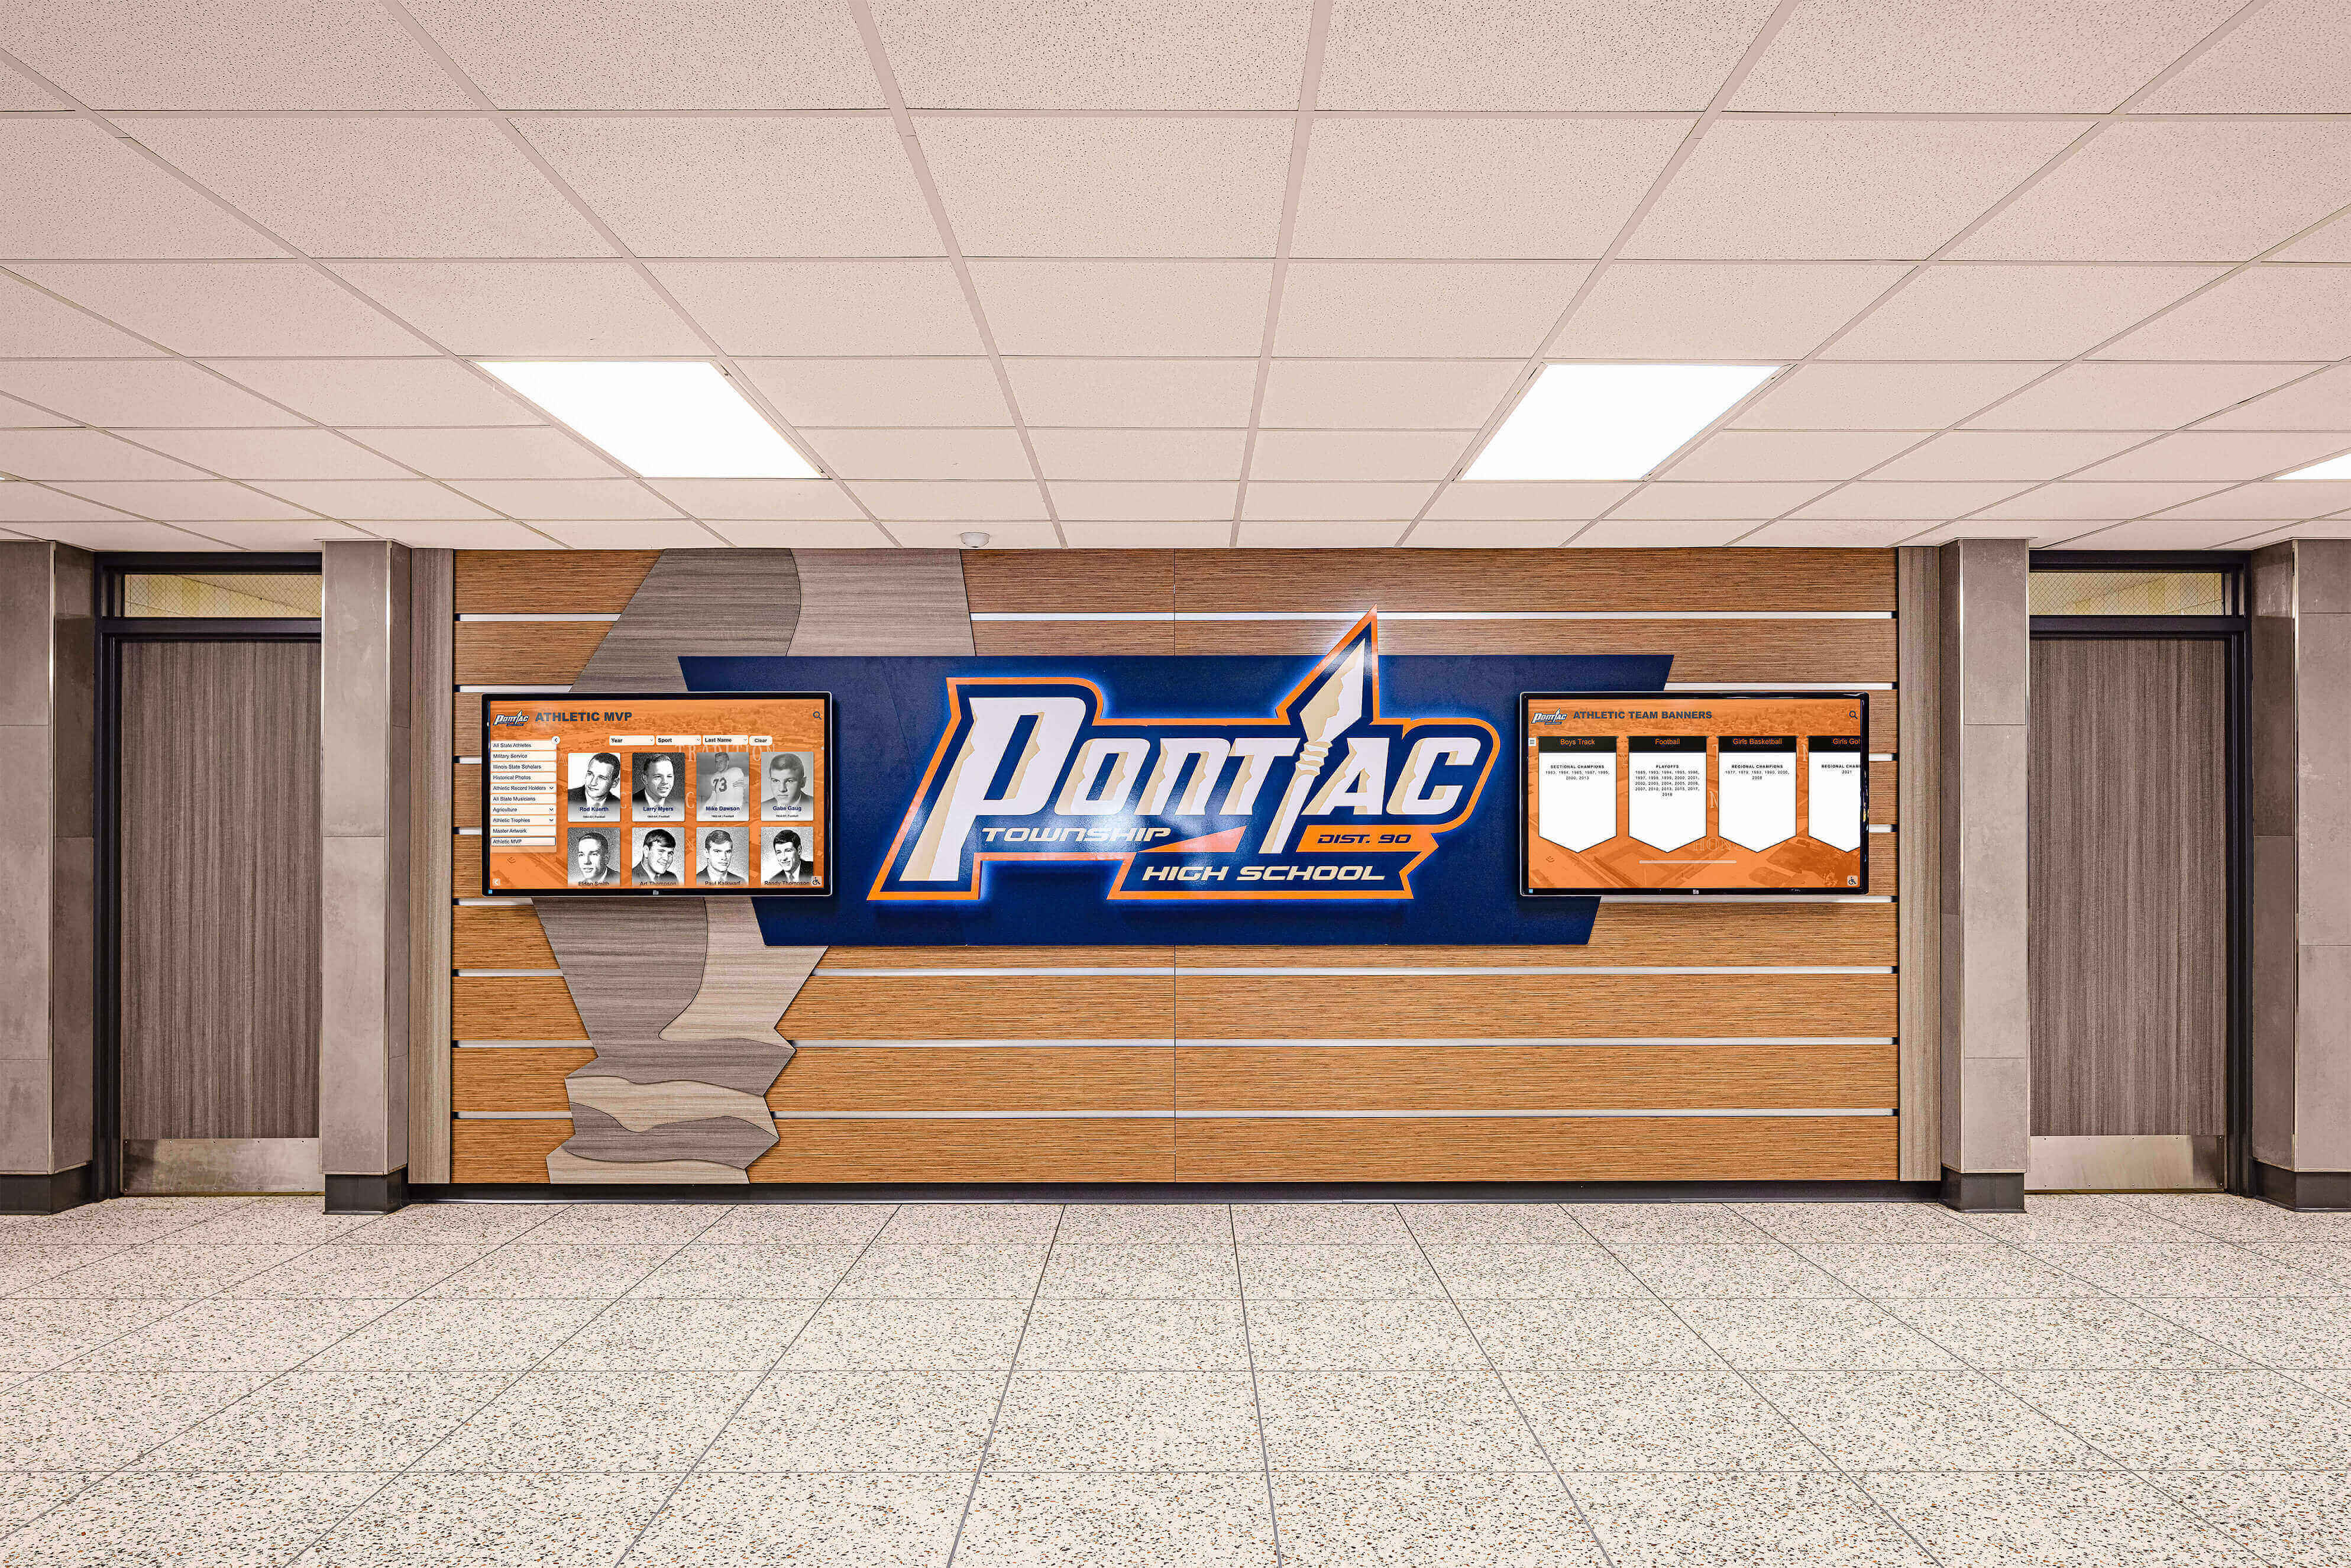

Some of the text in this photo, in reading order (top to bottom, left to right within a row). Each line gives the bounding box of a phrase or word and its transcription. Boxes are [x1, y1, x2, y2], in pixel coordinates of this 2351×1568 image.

[535, 712, 632, 722] ATHLETIC MVP
[1573, 711, 1712, 719] ATHLETIC TEAM BANNERS
[899, 638, 1481, 881] PONTIAC
[713, 777, 727, 793] 73
[982, 827, 1171, 842] TOWNSHIP
[1317, 834, 1412, 844] DIST. 90
[1142, 865, 1385, 881] HIGH SCHOOL
